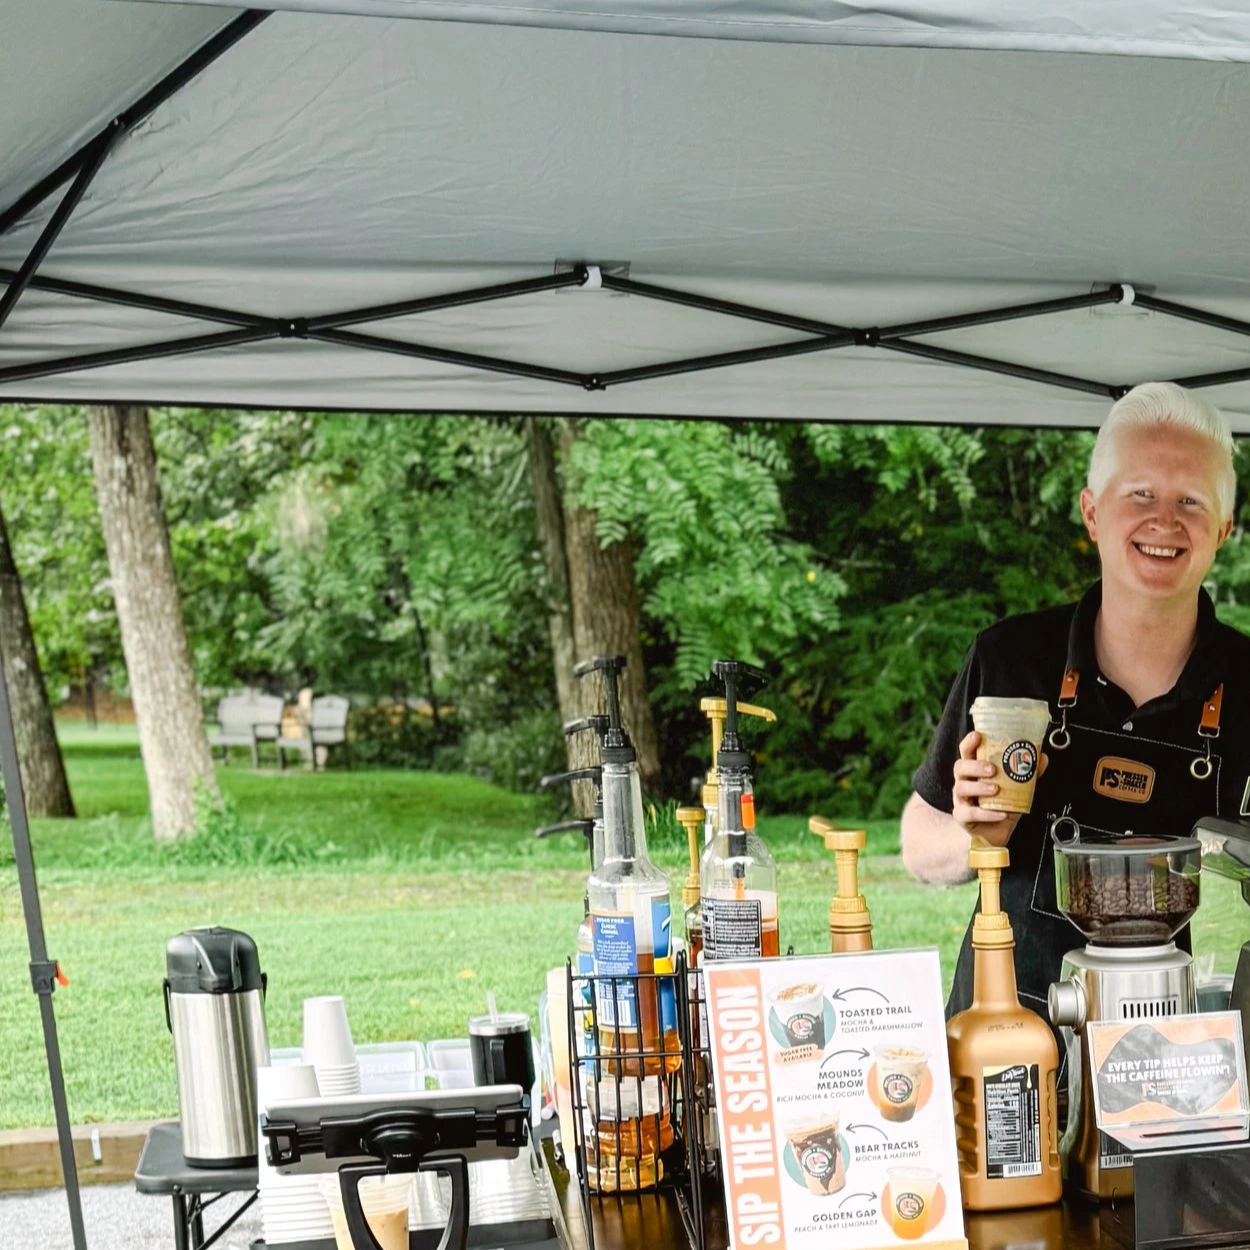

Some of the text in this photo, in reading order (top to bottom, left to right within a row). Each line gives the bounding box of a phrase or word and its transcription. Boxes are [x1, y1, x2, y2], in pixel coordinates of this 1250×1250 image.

[840, 1005, 912, 1018] TOASTED TRAIL
[841, 1019, 868, 1027] MOCHA
[841, 1022, 923, 1034] TOASTED MARSHMALLOW
[716, 985, 769, 1114] SEASON
[780, 1049, 799, 1058] SUGAR
[783, 1052, 812, 1062] AVAILABLE
[1107, 1054, 1224, 1073] EVERY TIP HELPS KEEP
[819, 1069, 863, 1079] MOUNDS
[1105, 1072, 1127, 1083] THE
[1128, 1069, 1179, 1082] CAFFEINE
[817, 1079, 864, 1090] MEADOW
[777, 1095, 793, 1103] RICH
[795, 1093, 822, 1101] MOCHA
[830, 1090, 865, 1099] COCONUT
[730, 1122, 775, 1184] THE
[855, 1140, 919, 1153] BEAR TRACKS
[889, 1151, 921, 1159] HAZELNUT
[737, 1193, 781, 1246] SIP
[812, 1209, 877, 1223] GOLDEN GAP
[794, 1224, 817, 1233] PEACH
[825, 1221, 840, 1229] TART
[841, 1219, 878, 1229] LEMONADE
